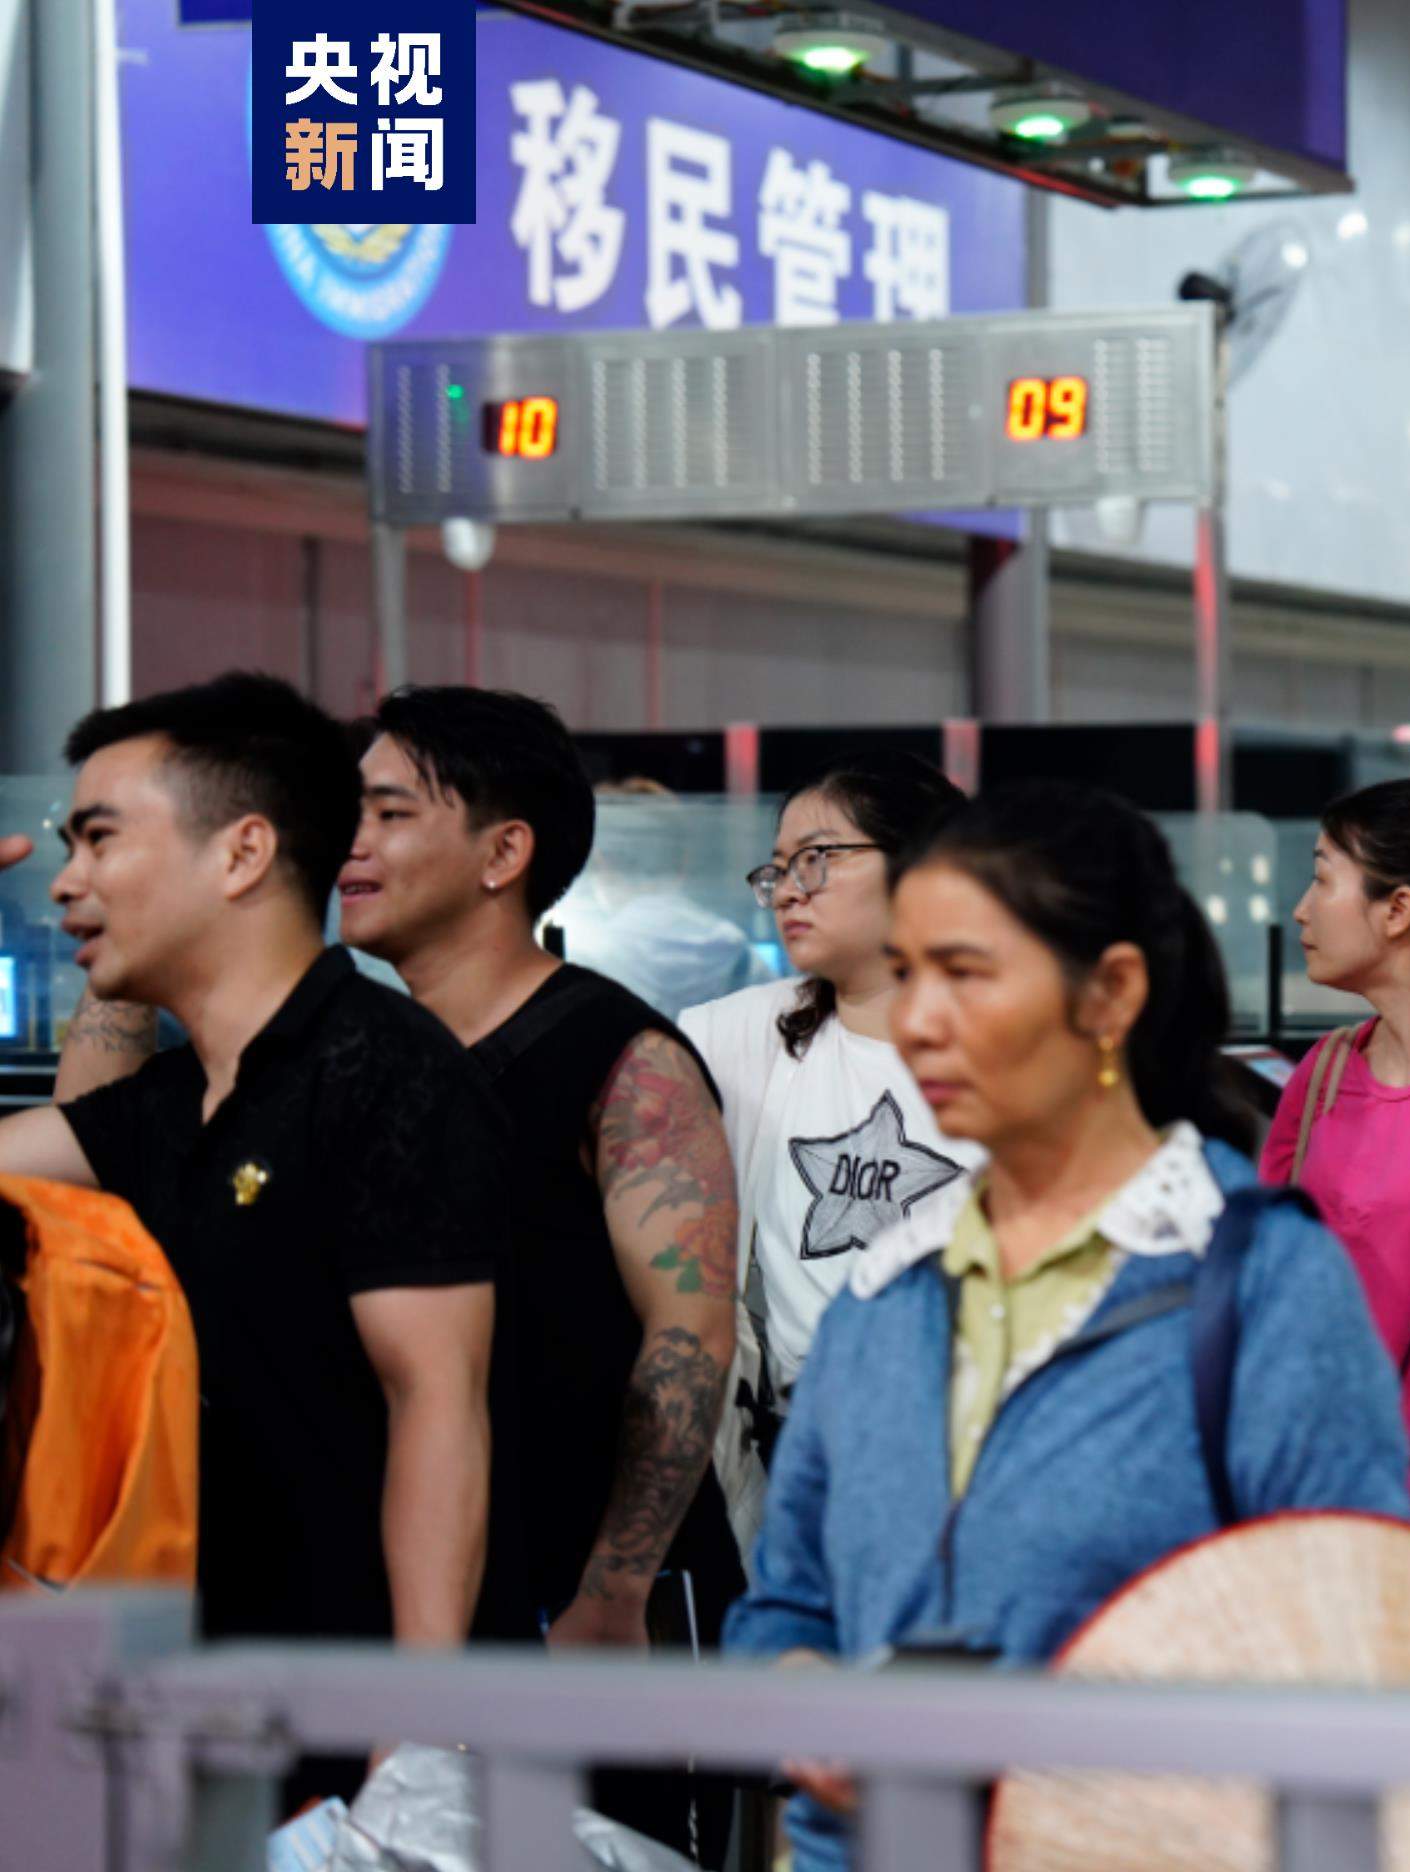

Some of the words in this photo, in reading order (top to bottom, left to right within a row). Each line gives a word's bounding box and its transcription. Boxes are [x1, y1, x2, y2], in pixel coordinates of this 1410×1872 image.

[510, 78, 951, 331] 移民管理
[497, 395, 560, 460] 10
[1006, 374, 1089, 443] 09
[829, 1152, 902, 1203] DIOR
